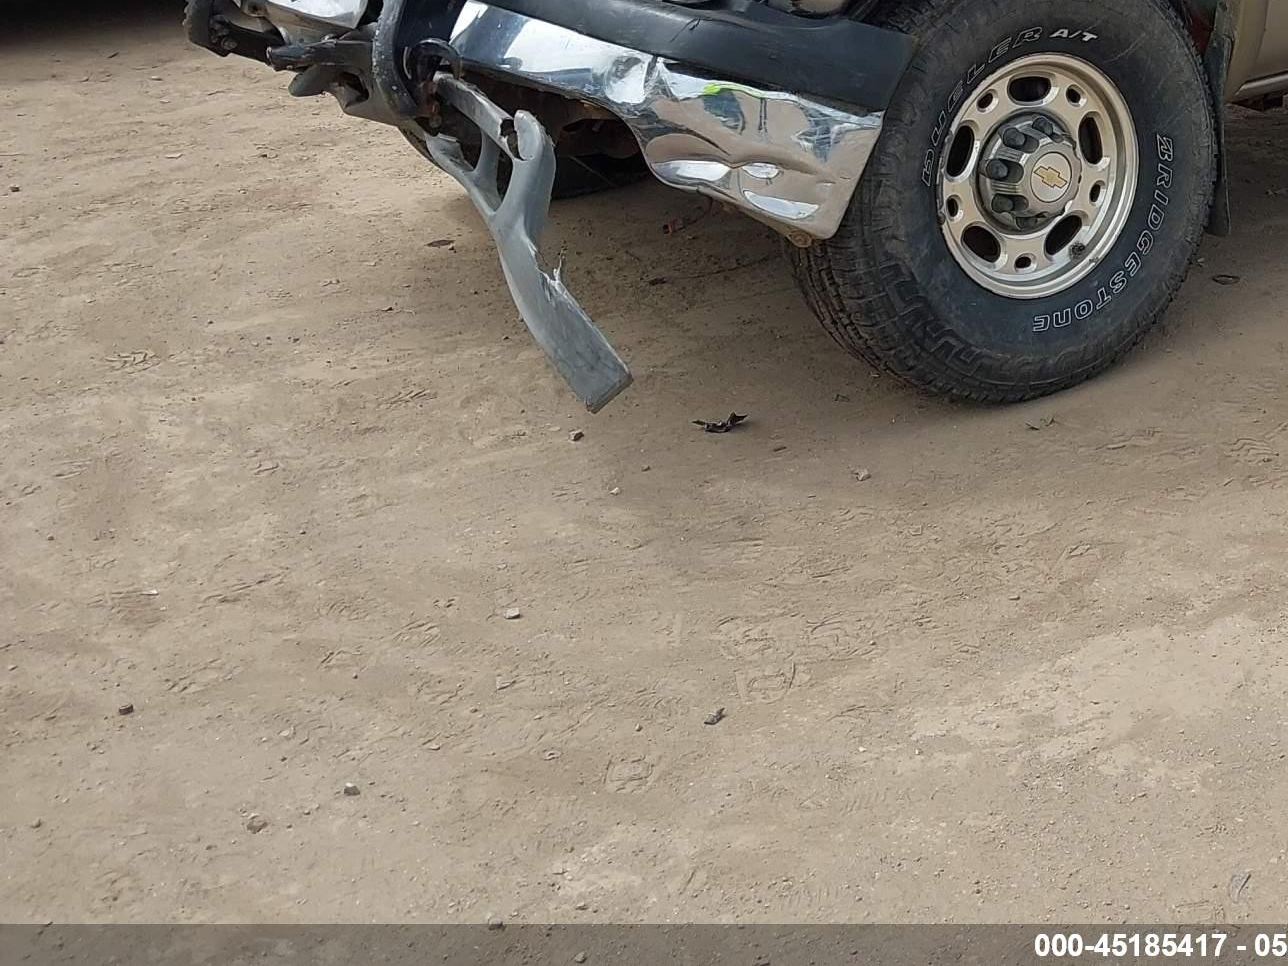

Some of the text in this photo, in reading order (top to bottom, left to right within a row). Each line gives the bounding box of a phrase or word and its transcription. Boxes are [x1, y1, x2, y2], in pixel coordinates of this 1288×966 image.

[921, 26, 1099, 187] DUELER A/T
[1031, 132, 1174, 333] BRIDGESTONE
